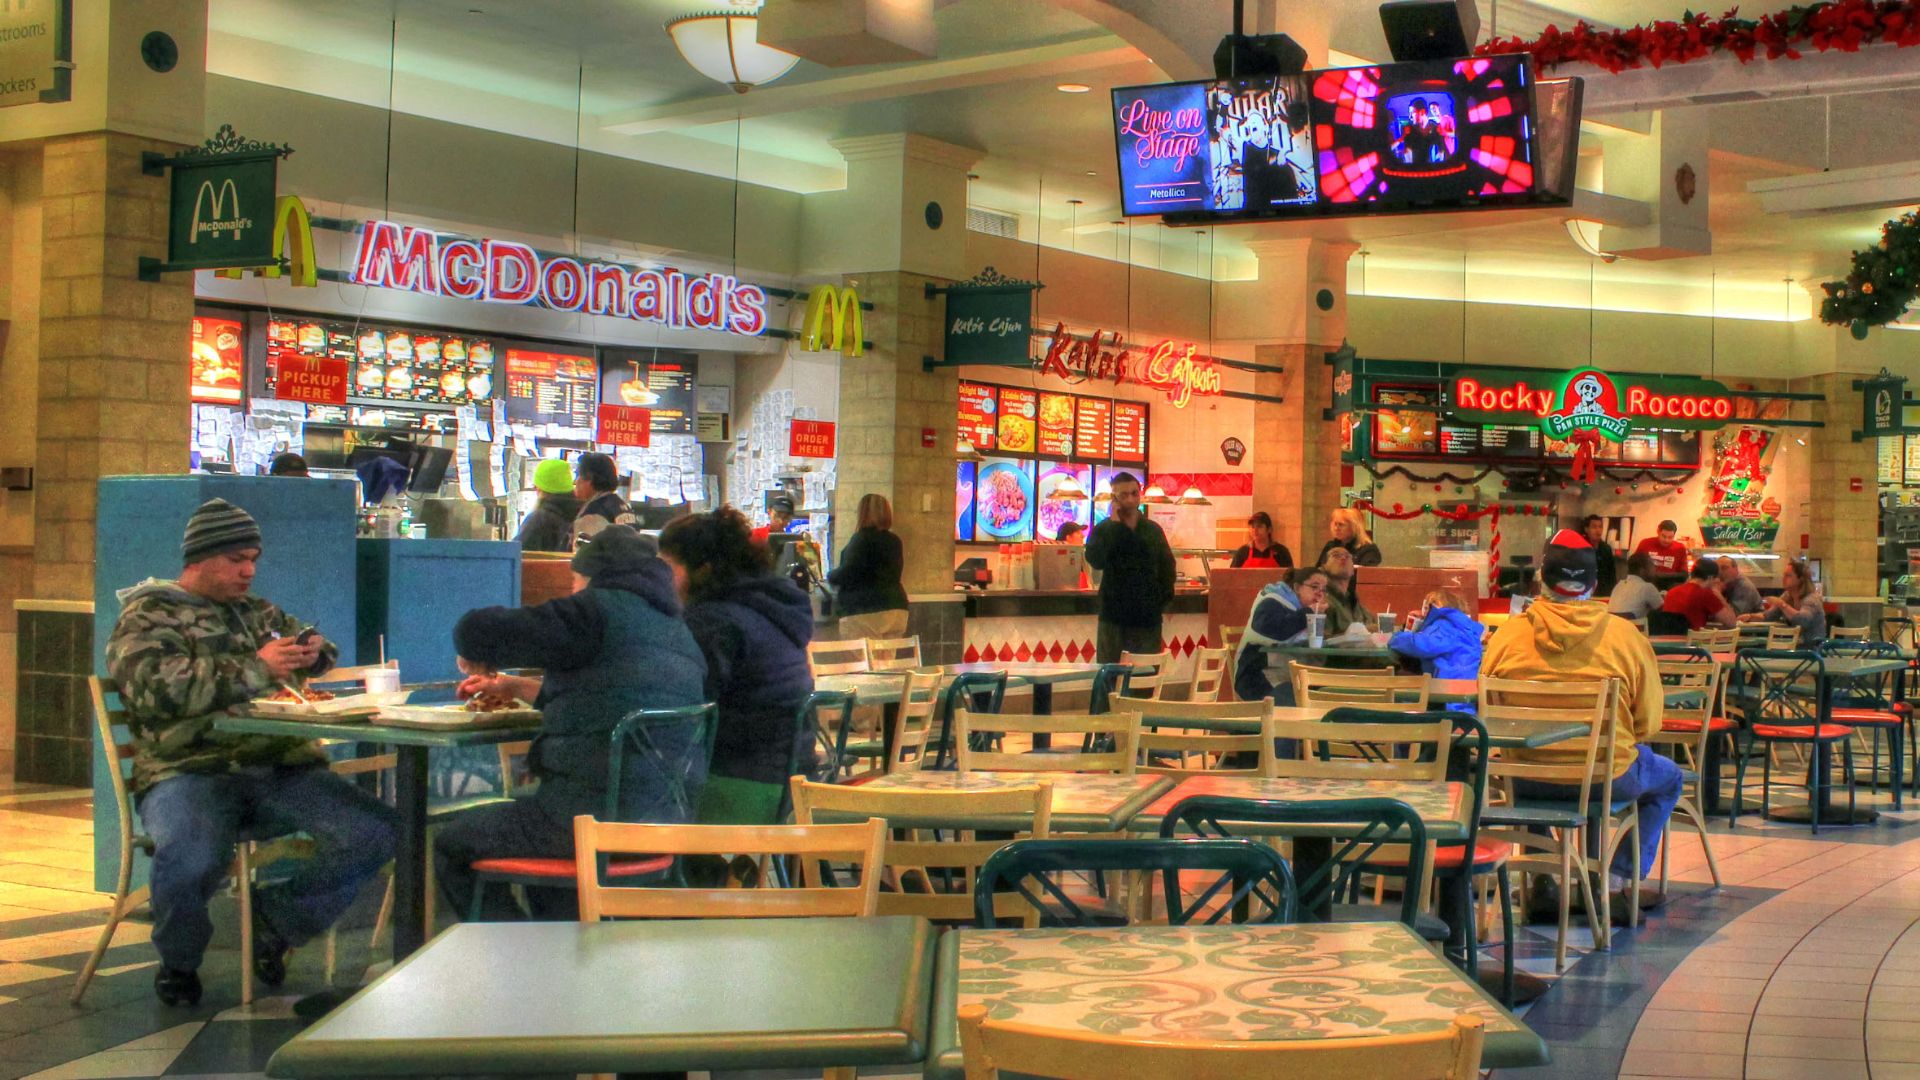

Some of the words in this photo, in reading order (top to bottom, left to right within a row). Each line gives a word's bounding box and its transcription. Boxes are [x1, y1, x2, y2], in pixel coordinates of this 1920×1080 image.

[1120, 99, 1174, 137] Live
[1175, 107, 1203, 130] on
[1136, 130, 1200, 173] Stage
[1150, 187, 1186, 199] Metallica
[198, 218, 253, 232] McDonald's
[348, 219, 768, 336] McDonald's
[988, 317, 1022, 337] Cajun
[283, 370, 341, 387] PICKUP
[1148, 339, 1222, 409] Cajun
[291, 386, 332, 400] HERE
[1458, 380, 1553, 416] Rocky
[1629, 388, 1731, 418] Rococo
[604, 420, 643, 432] ORDER
[1556, 419, 1573, 433] PAN
[1574, 415, 1600, 426] STYLE
[1601, 418, 1625, 436] PIZZA
[607, 431, 639, 444] HERE
[796, 433, 829, 444] ORDER
[799, 443, 825, 455] HERE
[1428, 528, 1447, 537] THE
[1712, 526, 1741, 540] Salad
[1742, 527, 1766, 540] Bar
